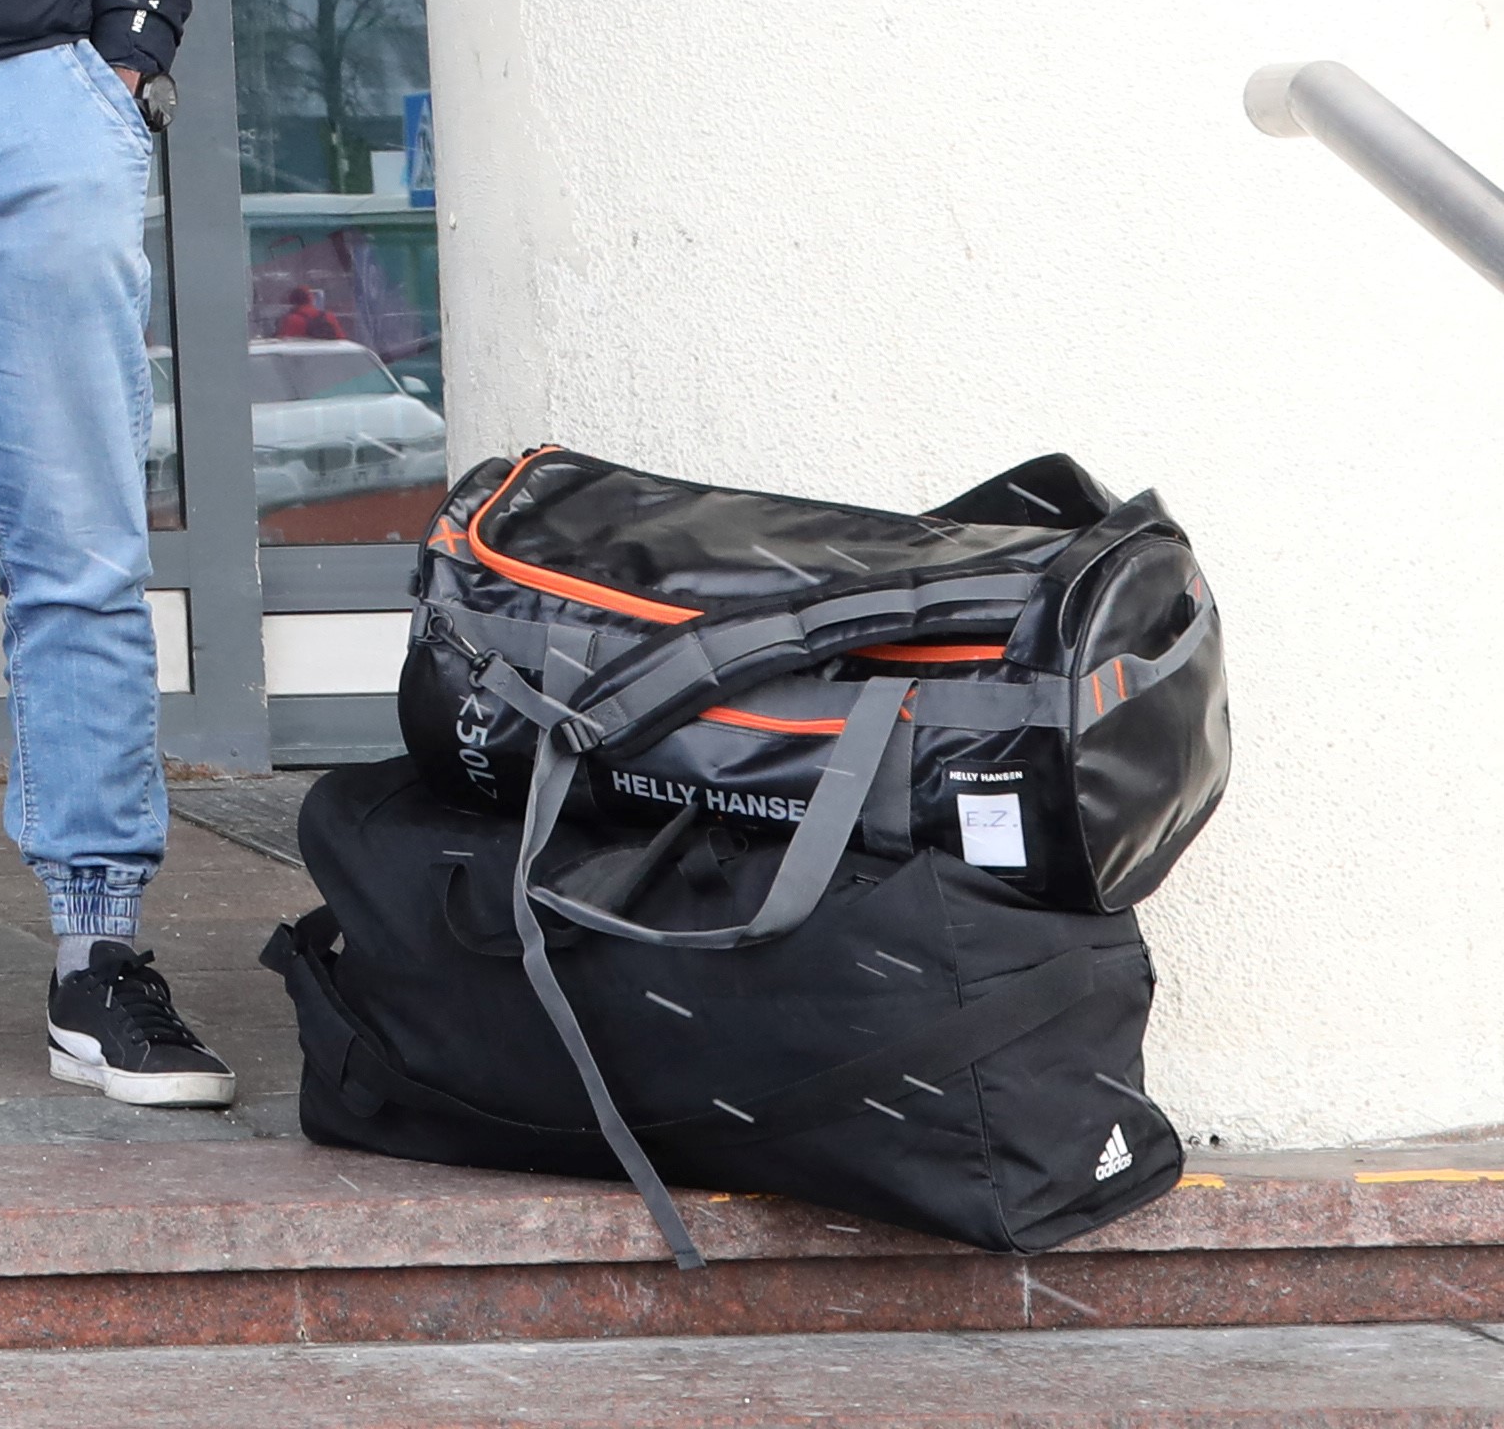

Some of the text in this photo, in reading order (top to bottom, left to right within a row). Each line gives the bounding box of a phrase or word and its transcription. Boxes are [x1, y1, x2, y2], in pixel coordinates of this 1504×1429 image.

[949, 770, 1023, 783] HELLY HANSEN
[611, 770, 808, 823] HELLY HANSE
[965, 809, 1019, 828] E.Z.
[1095, 1152, 1133, 1182] adidas
